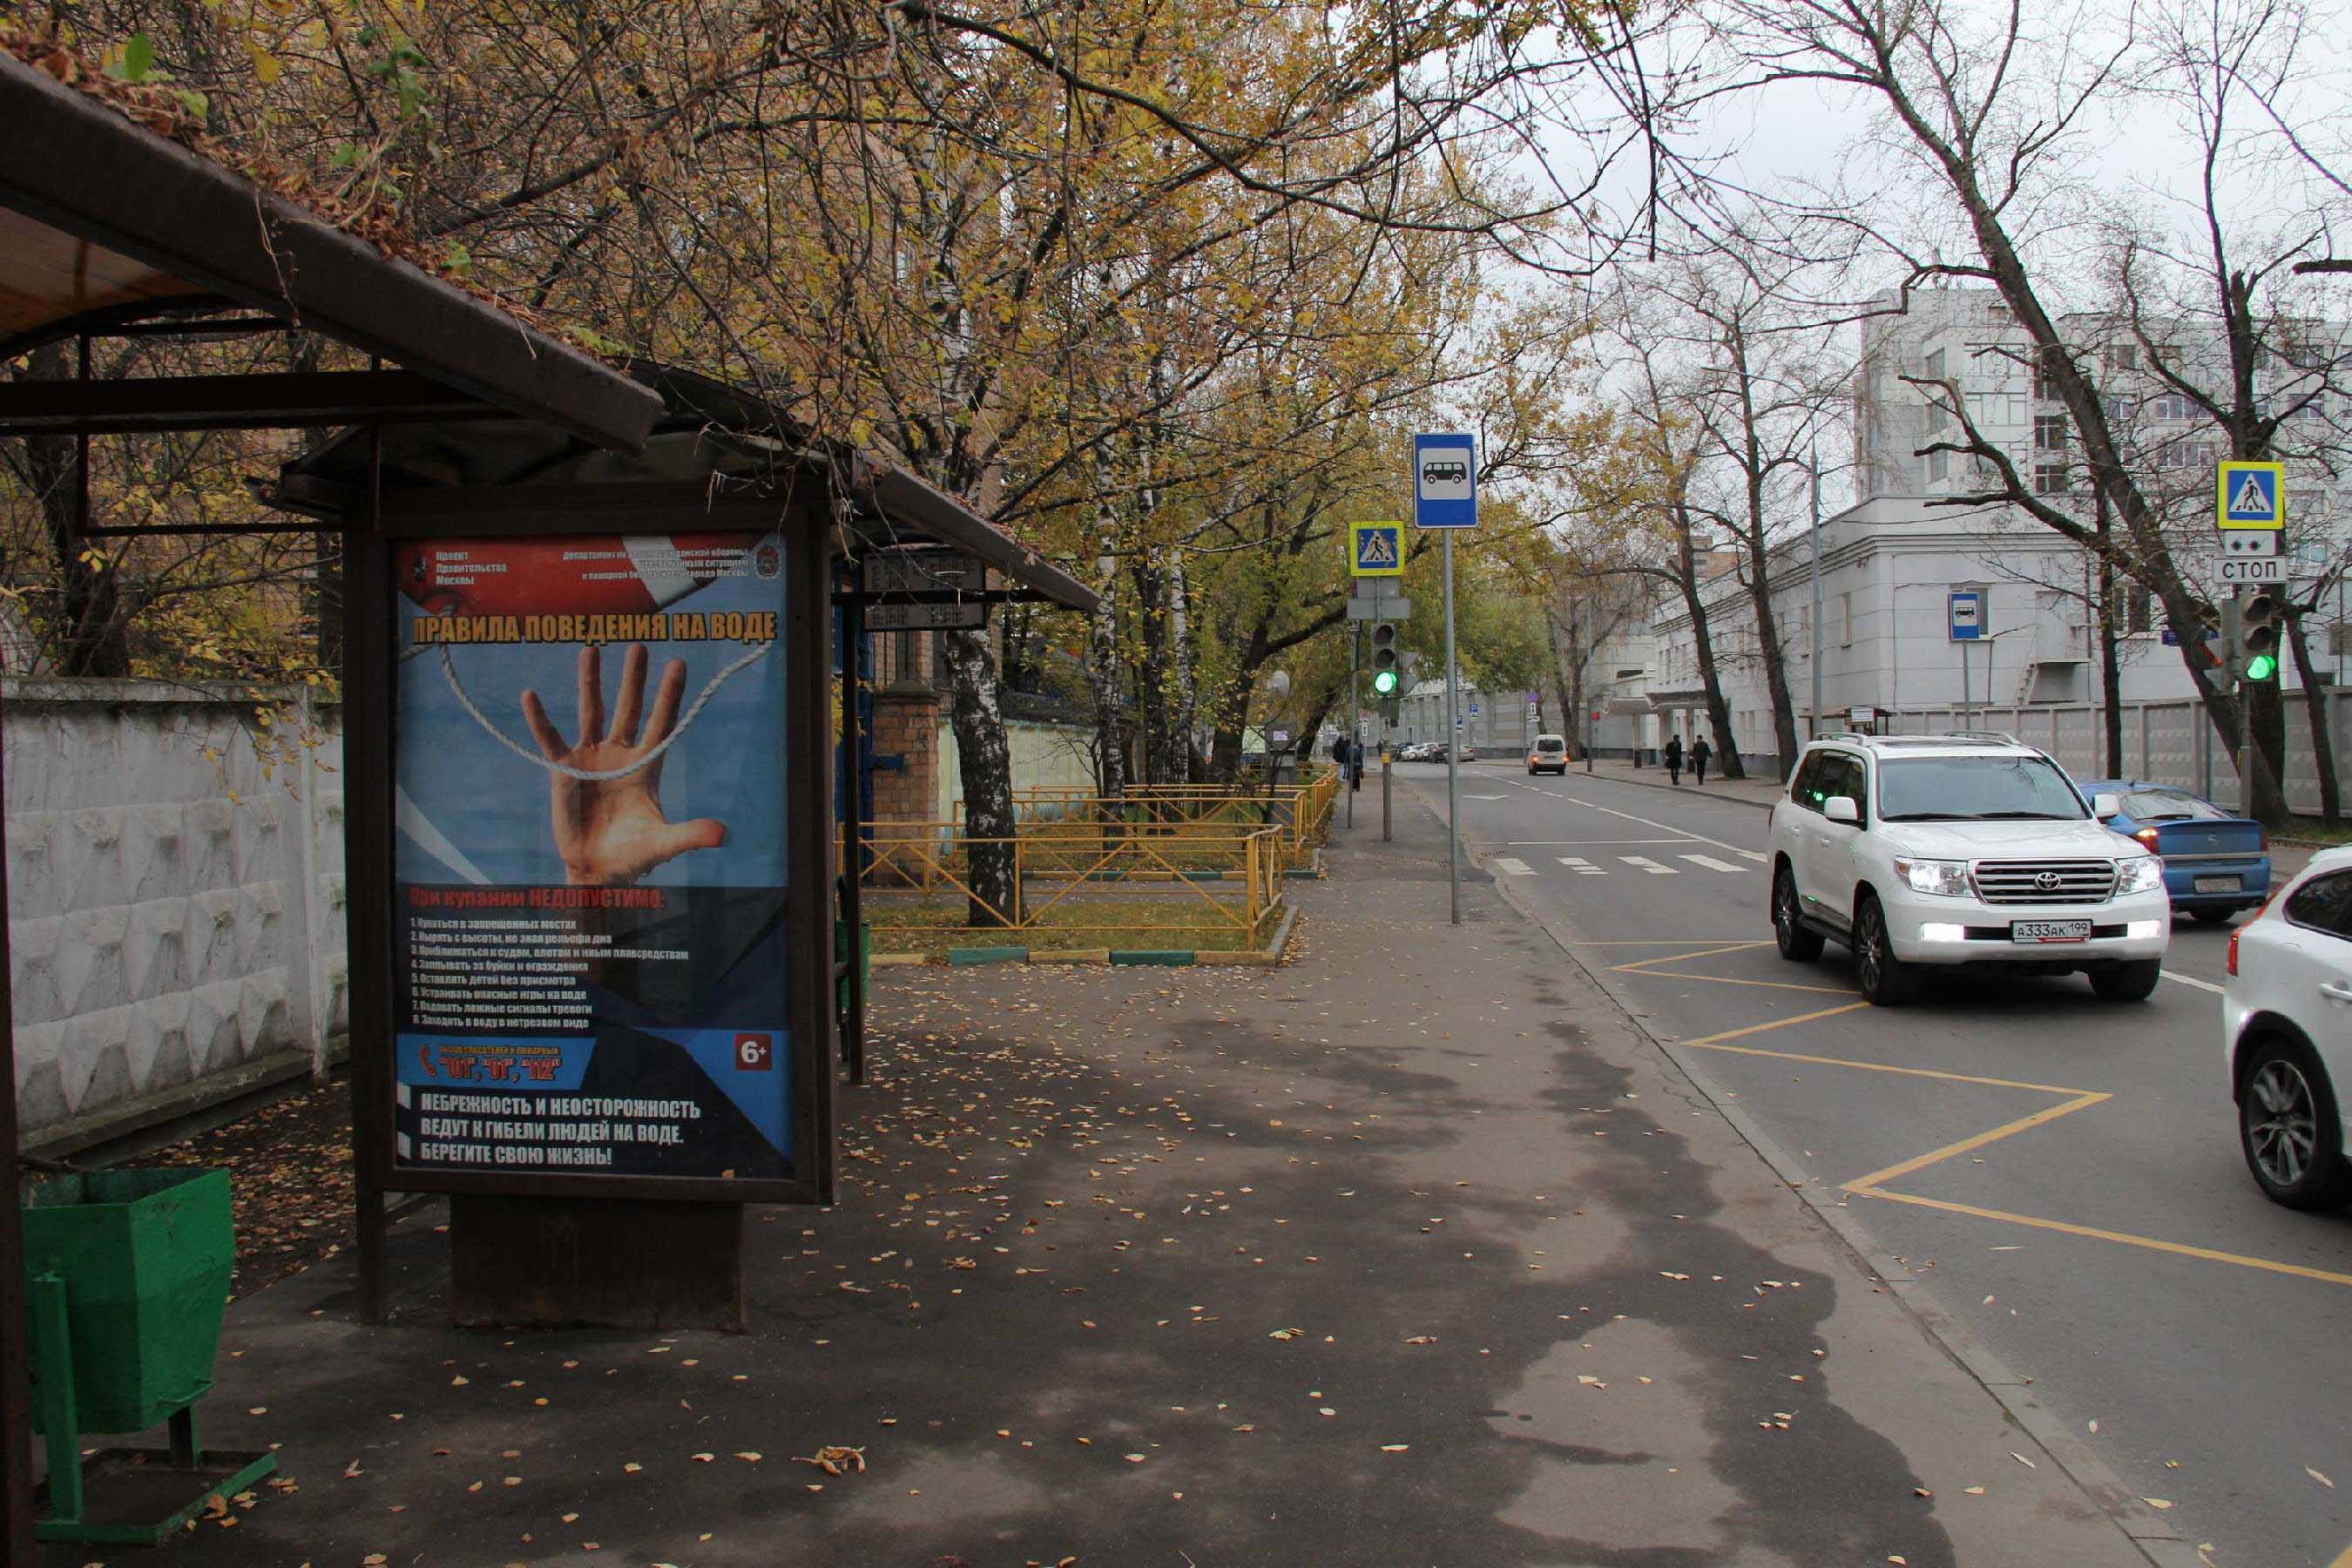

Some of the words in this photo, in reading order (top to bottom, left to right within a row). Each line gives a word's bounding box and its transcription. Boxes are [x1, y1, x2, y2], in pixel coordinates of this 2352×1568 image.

[436, 564, 508, 574] Правительства
[2222, 561, 2277, 579] СТОП
[436, 576, 475, 585] Москвы
[414, 615, 521, 644] ПРАВИЛА
[524, 614, 667, 646] ПОВЕДЕНИЯ
[672, 613, 709, 641] НА
[709, 612, 778, 645] ВОДЕ
[410, 886, 440, 908] При
[443, 889, 524, 909] купании
[418, 918, 458, 929] Купаться
[460, 921, 466, 929] в
[468, 920, 538, 929] запрещенных
[540, 920, 577, 929] местах
[2070, 922, 2087, 932] 199
[418, 931, 454, 944] Нырять
[455, 934, 460, 943] с
[505, 935, 517, 943] не
[519, 935, 544, 944] зная
[544, 934, 591, 945] рельефа
[591, 934, 612, 944] дна
[418, 944, 489, 956] Приближаться
[490, 948, 497, 956] к
[534, 949, 571, 958] плотам
[573, 949, 580, 958] и
[582, 949, 612, 959] иным
[613, 949, 689, 960] плавсредствам
[419, 959, 471, 970] Заплывать
[473, 962, 483, 970] за
[485, 960, 516, 971] буйки
[517, 963, 524, 971] и
[525, 963, 589, 972] ограждения
[420, 973, 467, 984] Оставлять
[469, 974, 499, 985] детей
[500, 975, 518, 985] без
[520, 976, 576, 986] присмотра
[420, 987, 472, 998] Устраивать
[474, 990, 517, 999] опасные
[519, 990, 545, 1001] игры
[547, 991, 559, 1000] на
[561, 991, 587, 1001] воде
[419, 1001, 462, 1013] Подавать
[463, 1004, 505, 1013] ложные
[507, 1004, 551, 1014] сигналы
[552, 1005, 592, 1015] тревоги
[422, 1015, 463, 1026] Заходить
[465, 1017, 471, 1026] в
[473, 1017, 497, 1028] воду
[498, 1018, 505, 1027] в
[507, 1018, 561, 1028] нетрезвом
[563, 1018, 589, 1029] виде
[740, 1040, 767, 1064] 6+
[421, 1092, 531, 1117] НЕБРЕЖНОСТЬ
[536, 1096, 546, 1116] И
[550, 1098, 701, 1119] НЕОСТОРОЖНОСТЬ
[421, 1118, 469, 1139] ВЕДУТ
[472, 1119, 483, 1139] К
[485, 1120, 545, 1140] ГИБЕЛИ
[547, 1119, 610, 1144] ЛЮДЕЙ
[613, 1123, 634, 1142] НА
[637, 1124, 685, 1146] ВОДЕ.
[421, 1142, 492, 1163] БЕРЕГИТЕ
[495, 1146, 544, 1164] СВОЮ
[546, 1146, 612, 1166] ЖИЗНЬ!
